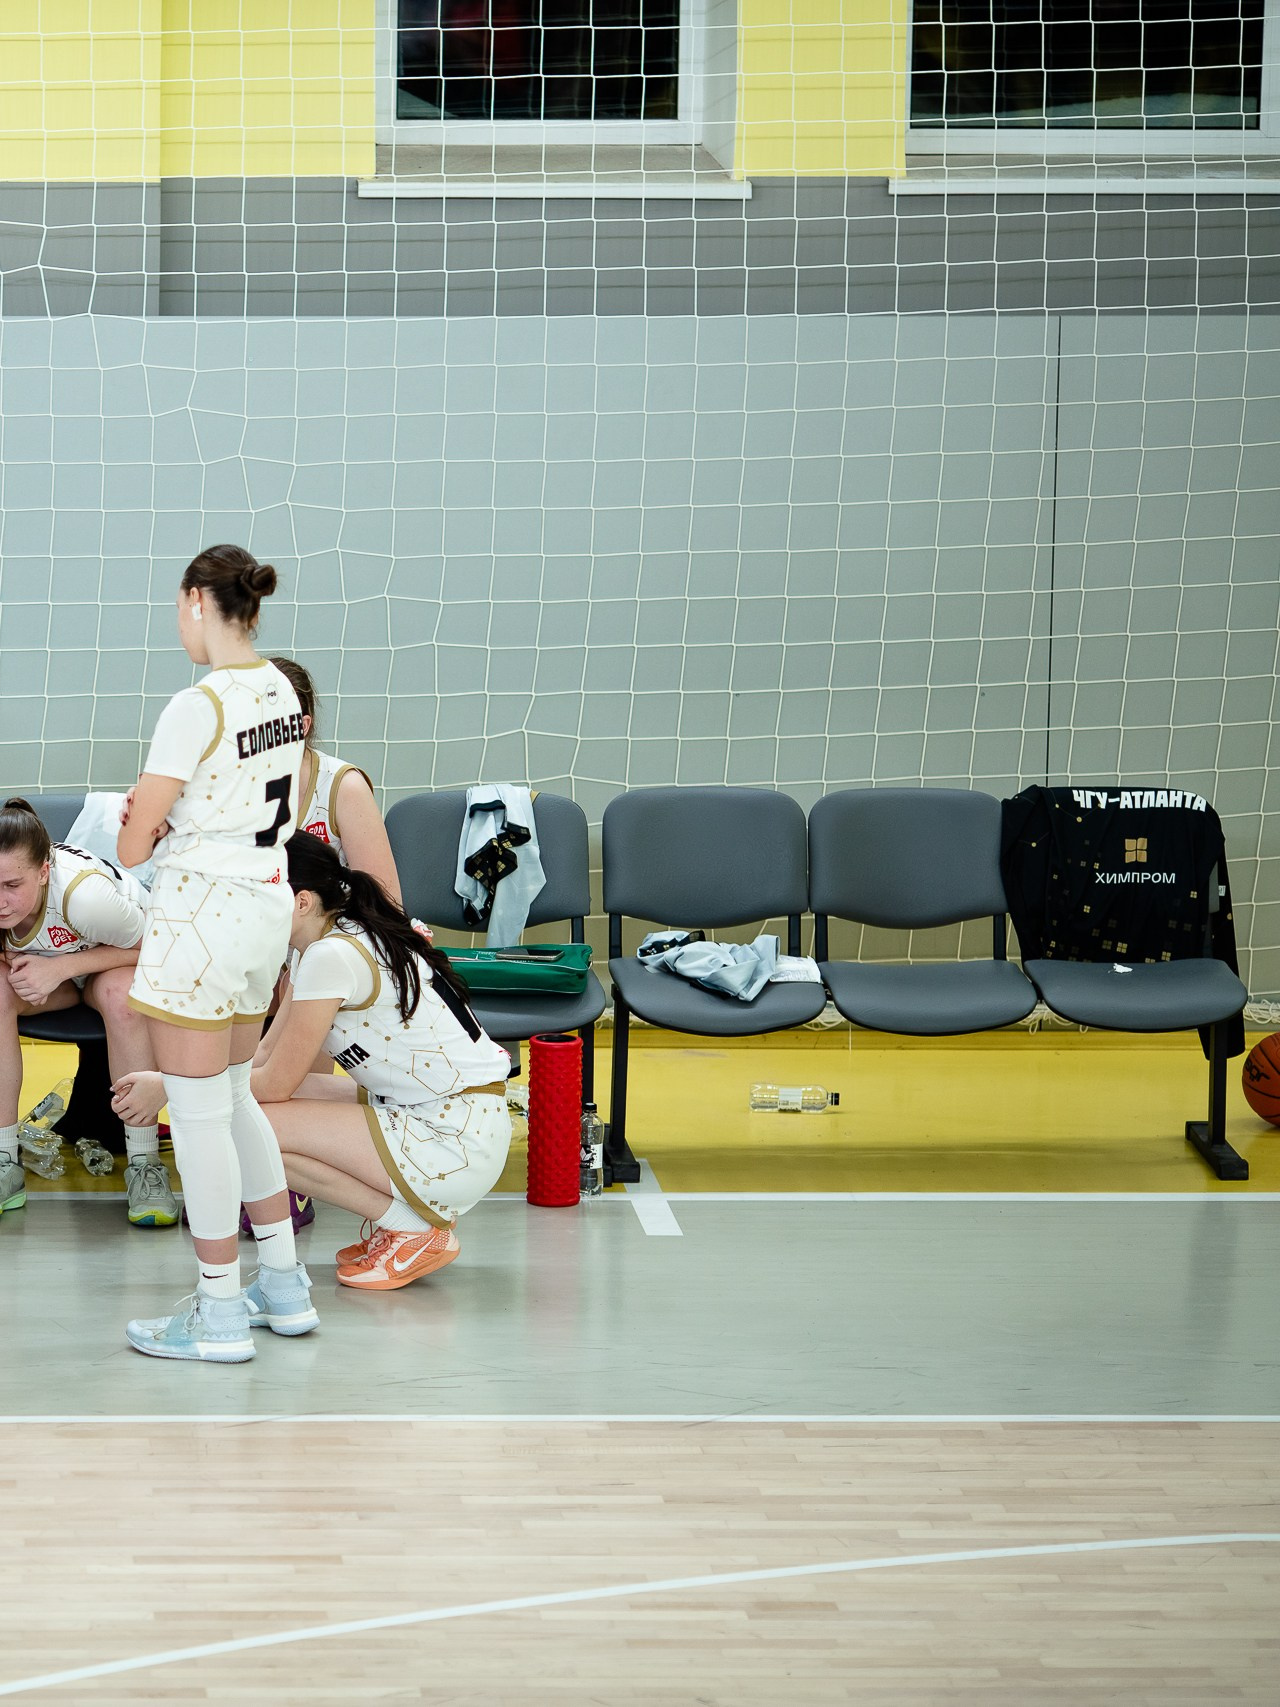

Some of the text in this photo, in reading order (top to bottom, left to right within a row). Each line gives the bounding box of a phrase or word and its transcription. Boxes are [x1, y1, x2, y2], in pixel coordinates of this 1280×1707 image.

[255, 774, 293, 847] 7
[1072, 789, 1207, 812] ЧГУ-АТЛАНТА
[1095, 872, 1176, 884] ХИМПРОМ
